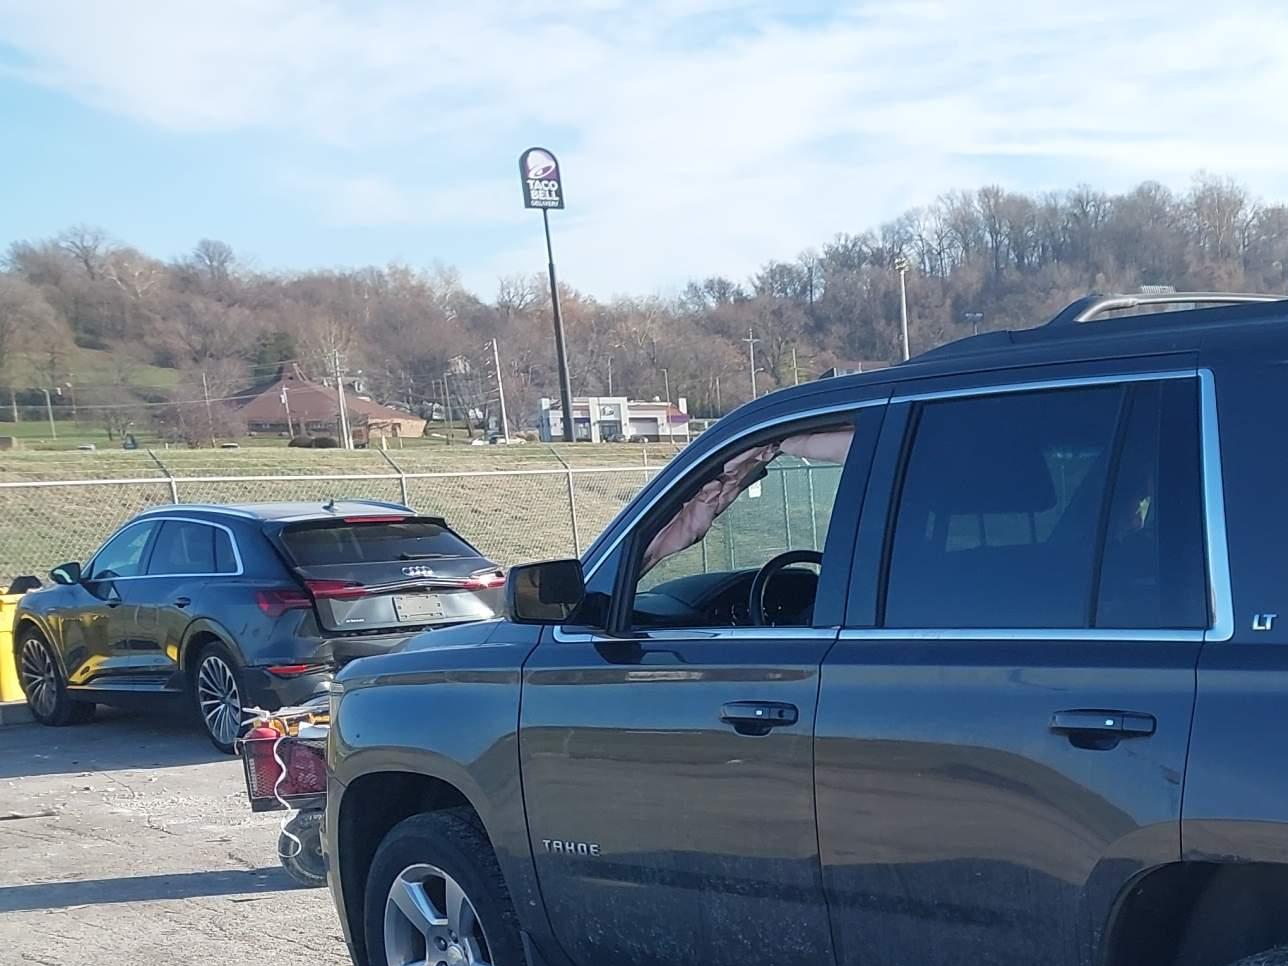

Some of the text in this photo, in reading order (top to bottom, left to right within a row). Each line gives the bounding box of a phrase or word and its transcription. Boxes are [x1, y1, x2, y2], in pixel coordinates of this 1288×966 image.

[525, 179, 559, 191] TACO
[530, 190, 560, 201] BELL
[1252, 613, 1278, 631] LT
[541, 839, 602, 857] TAHOE
